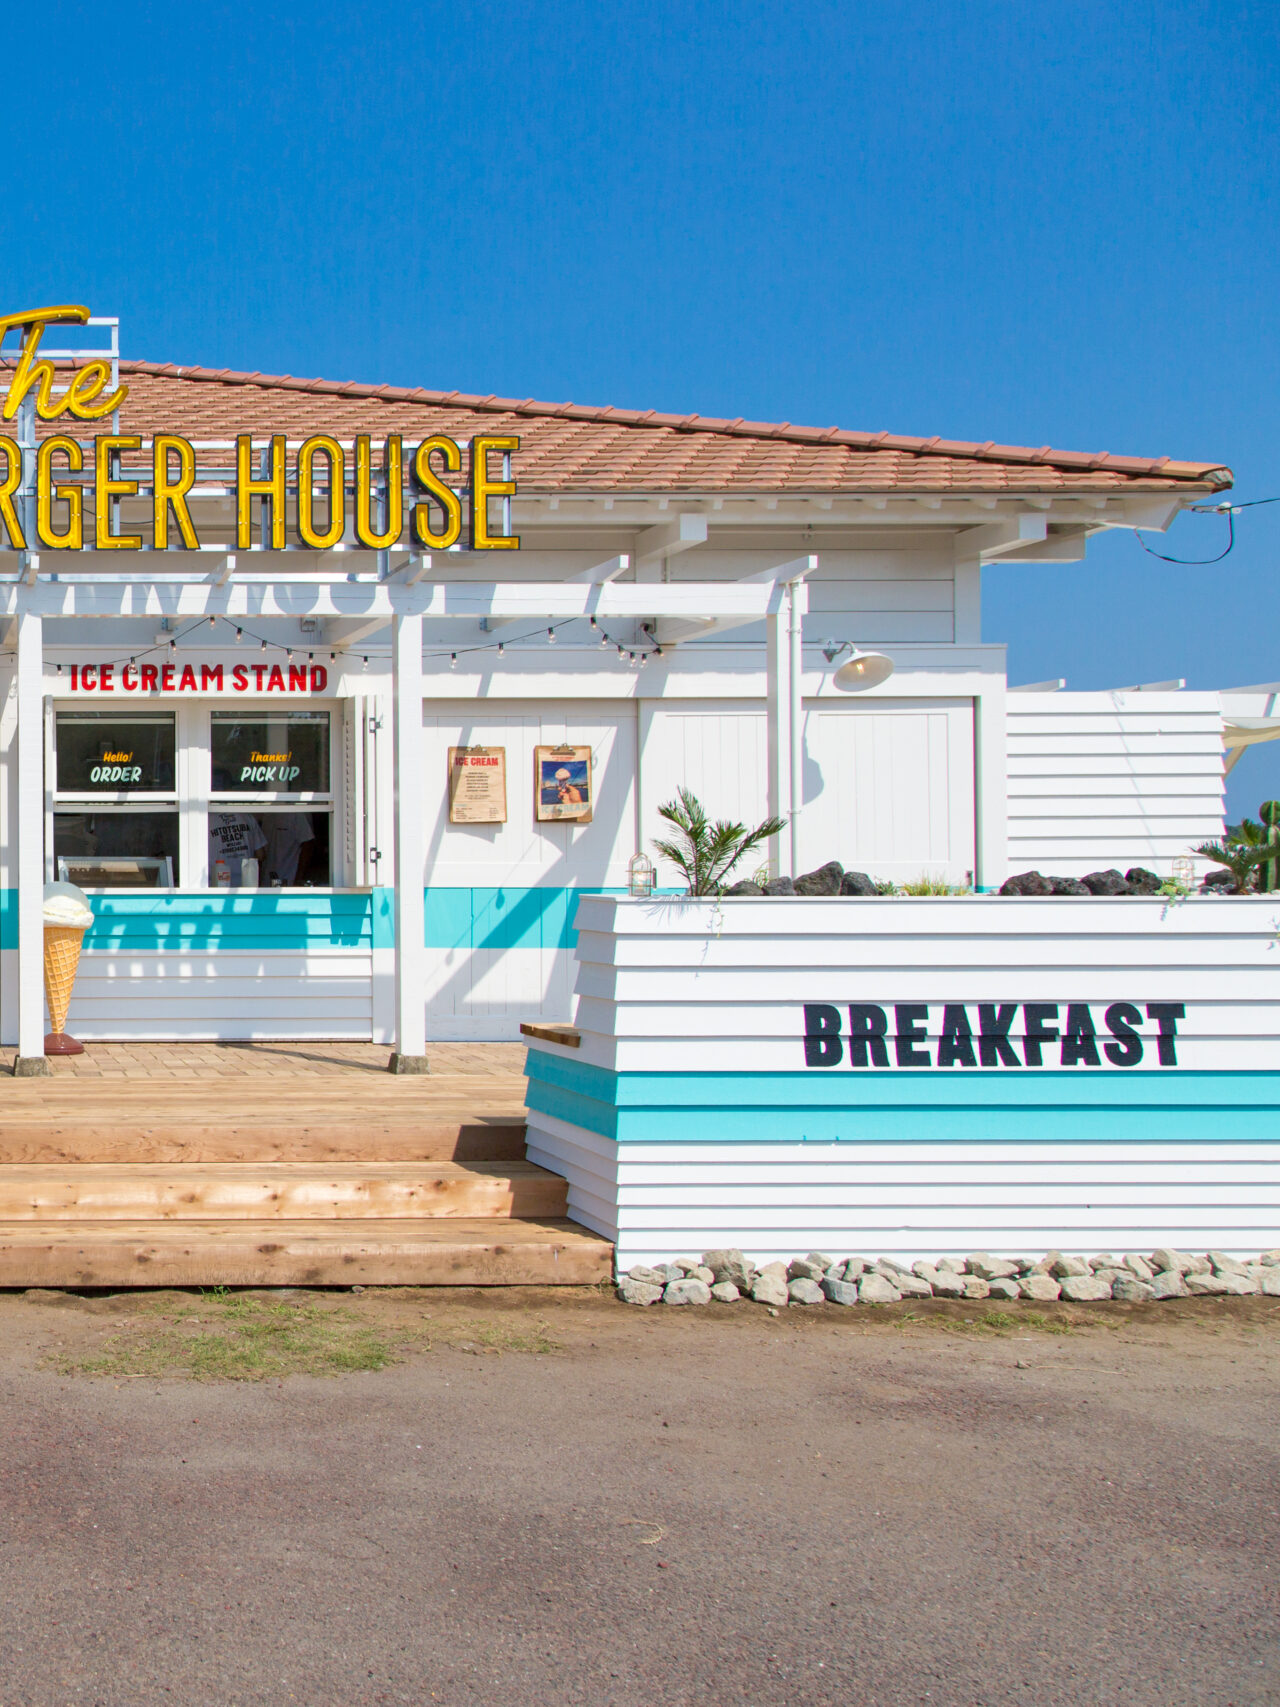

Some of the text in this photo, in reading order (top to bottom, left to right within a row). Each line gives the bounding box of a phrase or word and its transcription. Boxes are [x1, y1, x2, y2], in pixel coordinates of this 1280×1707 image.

[236, 434, 521, 551] HOUSE
[70, 664, 328, 692] ICE CREAM STAND
[103, 751, 133, 763] Hello!
[250, 751, 292, 763] Thanks!
[455, 757, 499, 766] ICE CREAM
[90, 766, 142, 783] ORDER
[240, 766, 300, 782] PICK UP
[802, 1003, 1187, 1068] BREAKFAST
